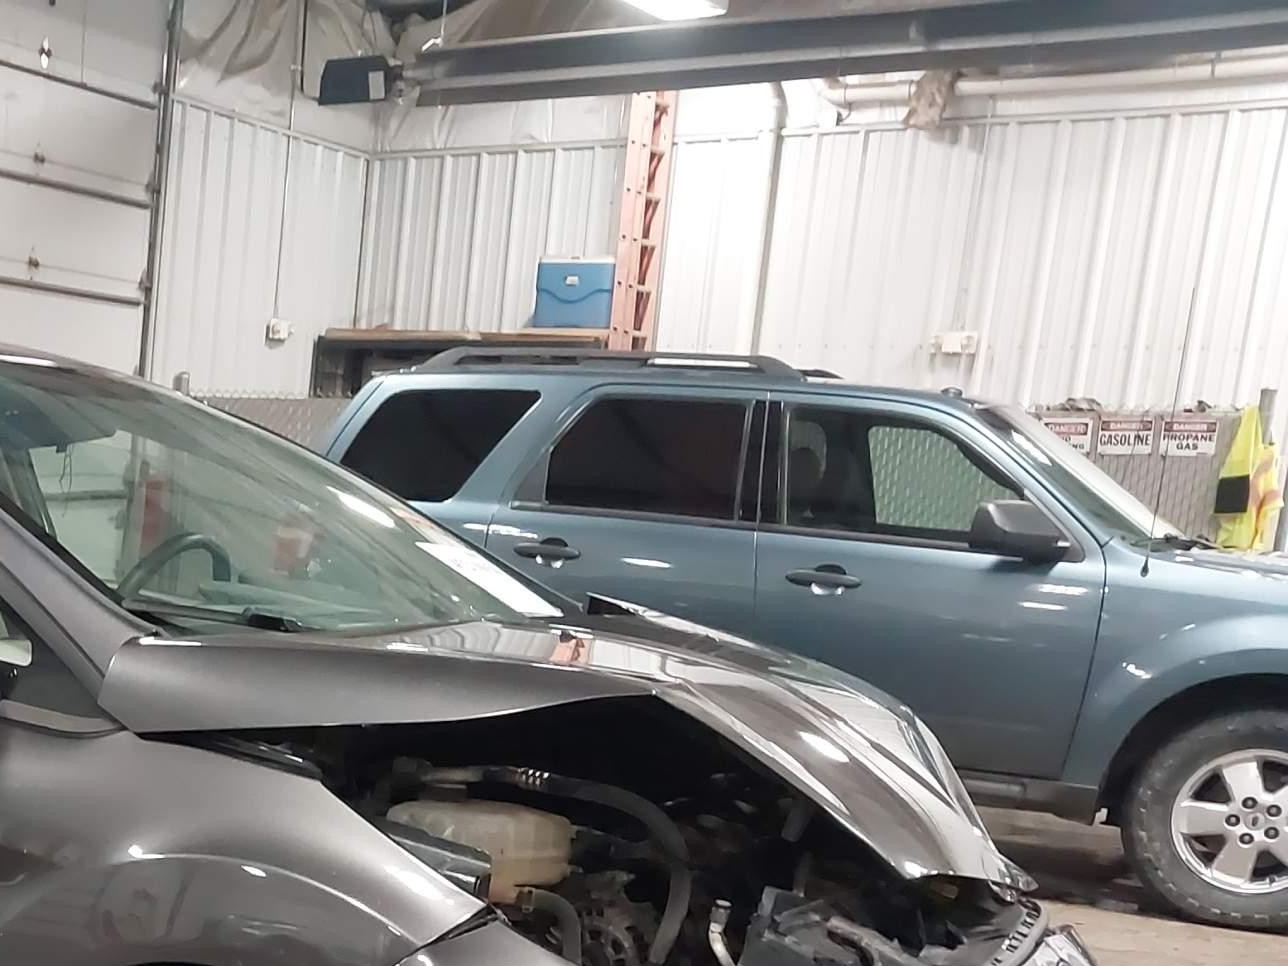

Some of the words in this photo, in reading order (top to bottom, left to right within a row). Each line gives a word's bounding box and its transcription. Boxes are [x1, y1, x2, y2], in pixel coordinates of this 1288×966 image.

[1099, 432, 1151, 447] GASOLINE
[1162, 433, 1214, 442] PROPANE
[1176, 442, 1199, 450] GAS
